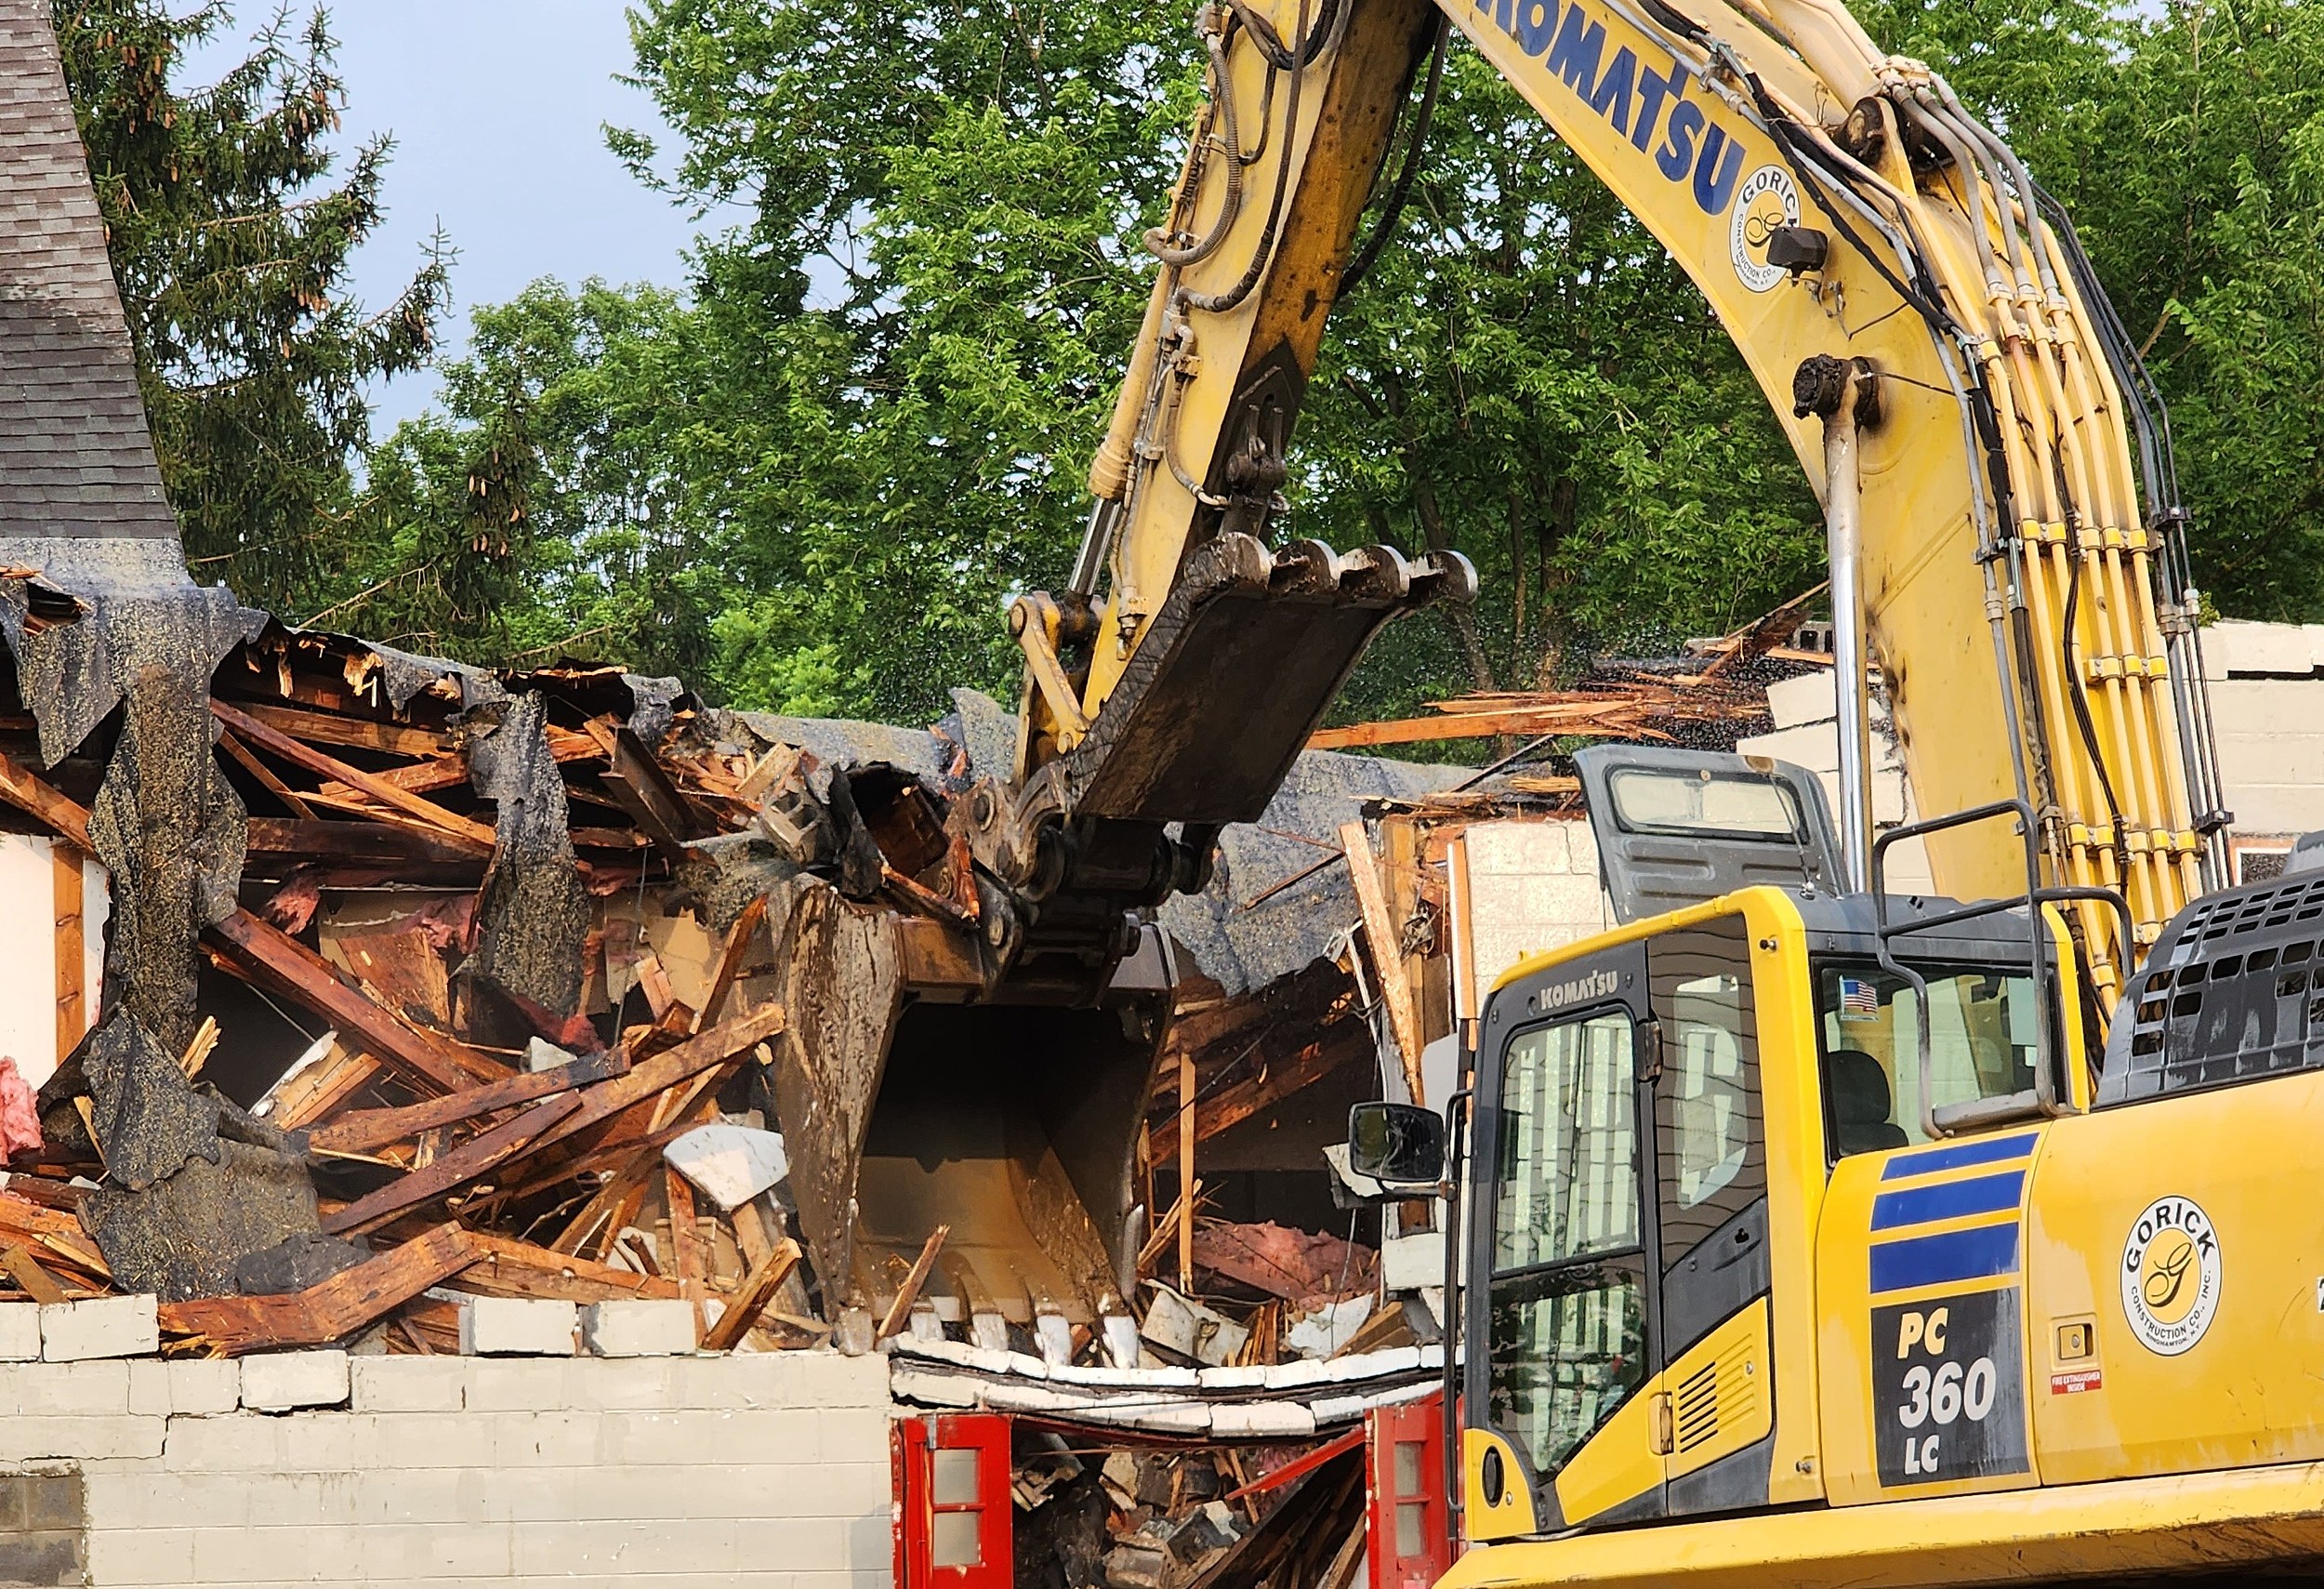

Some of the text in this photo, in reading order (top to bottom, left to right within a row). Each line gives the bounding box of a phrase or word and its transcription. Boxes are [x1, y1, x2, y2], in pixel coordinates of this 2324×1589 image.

[1736, 213, 1761, 278] CONSTRUCTION
[1540, 970, 1618, 1011] KOMATSU
[2126, 1202, 2216, 1273] GORICK
[1897, 1307, 1949, 1359] PC
[2131, 1286, 2187, 1339] CONSTRUCTION
[1899, 1357, 1997, 1428] 360
[1904, 1435, 1939, 1475] LC
